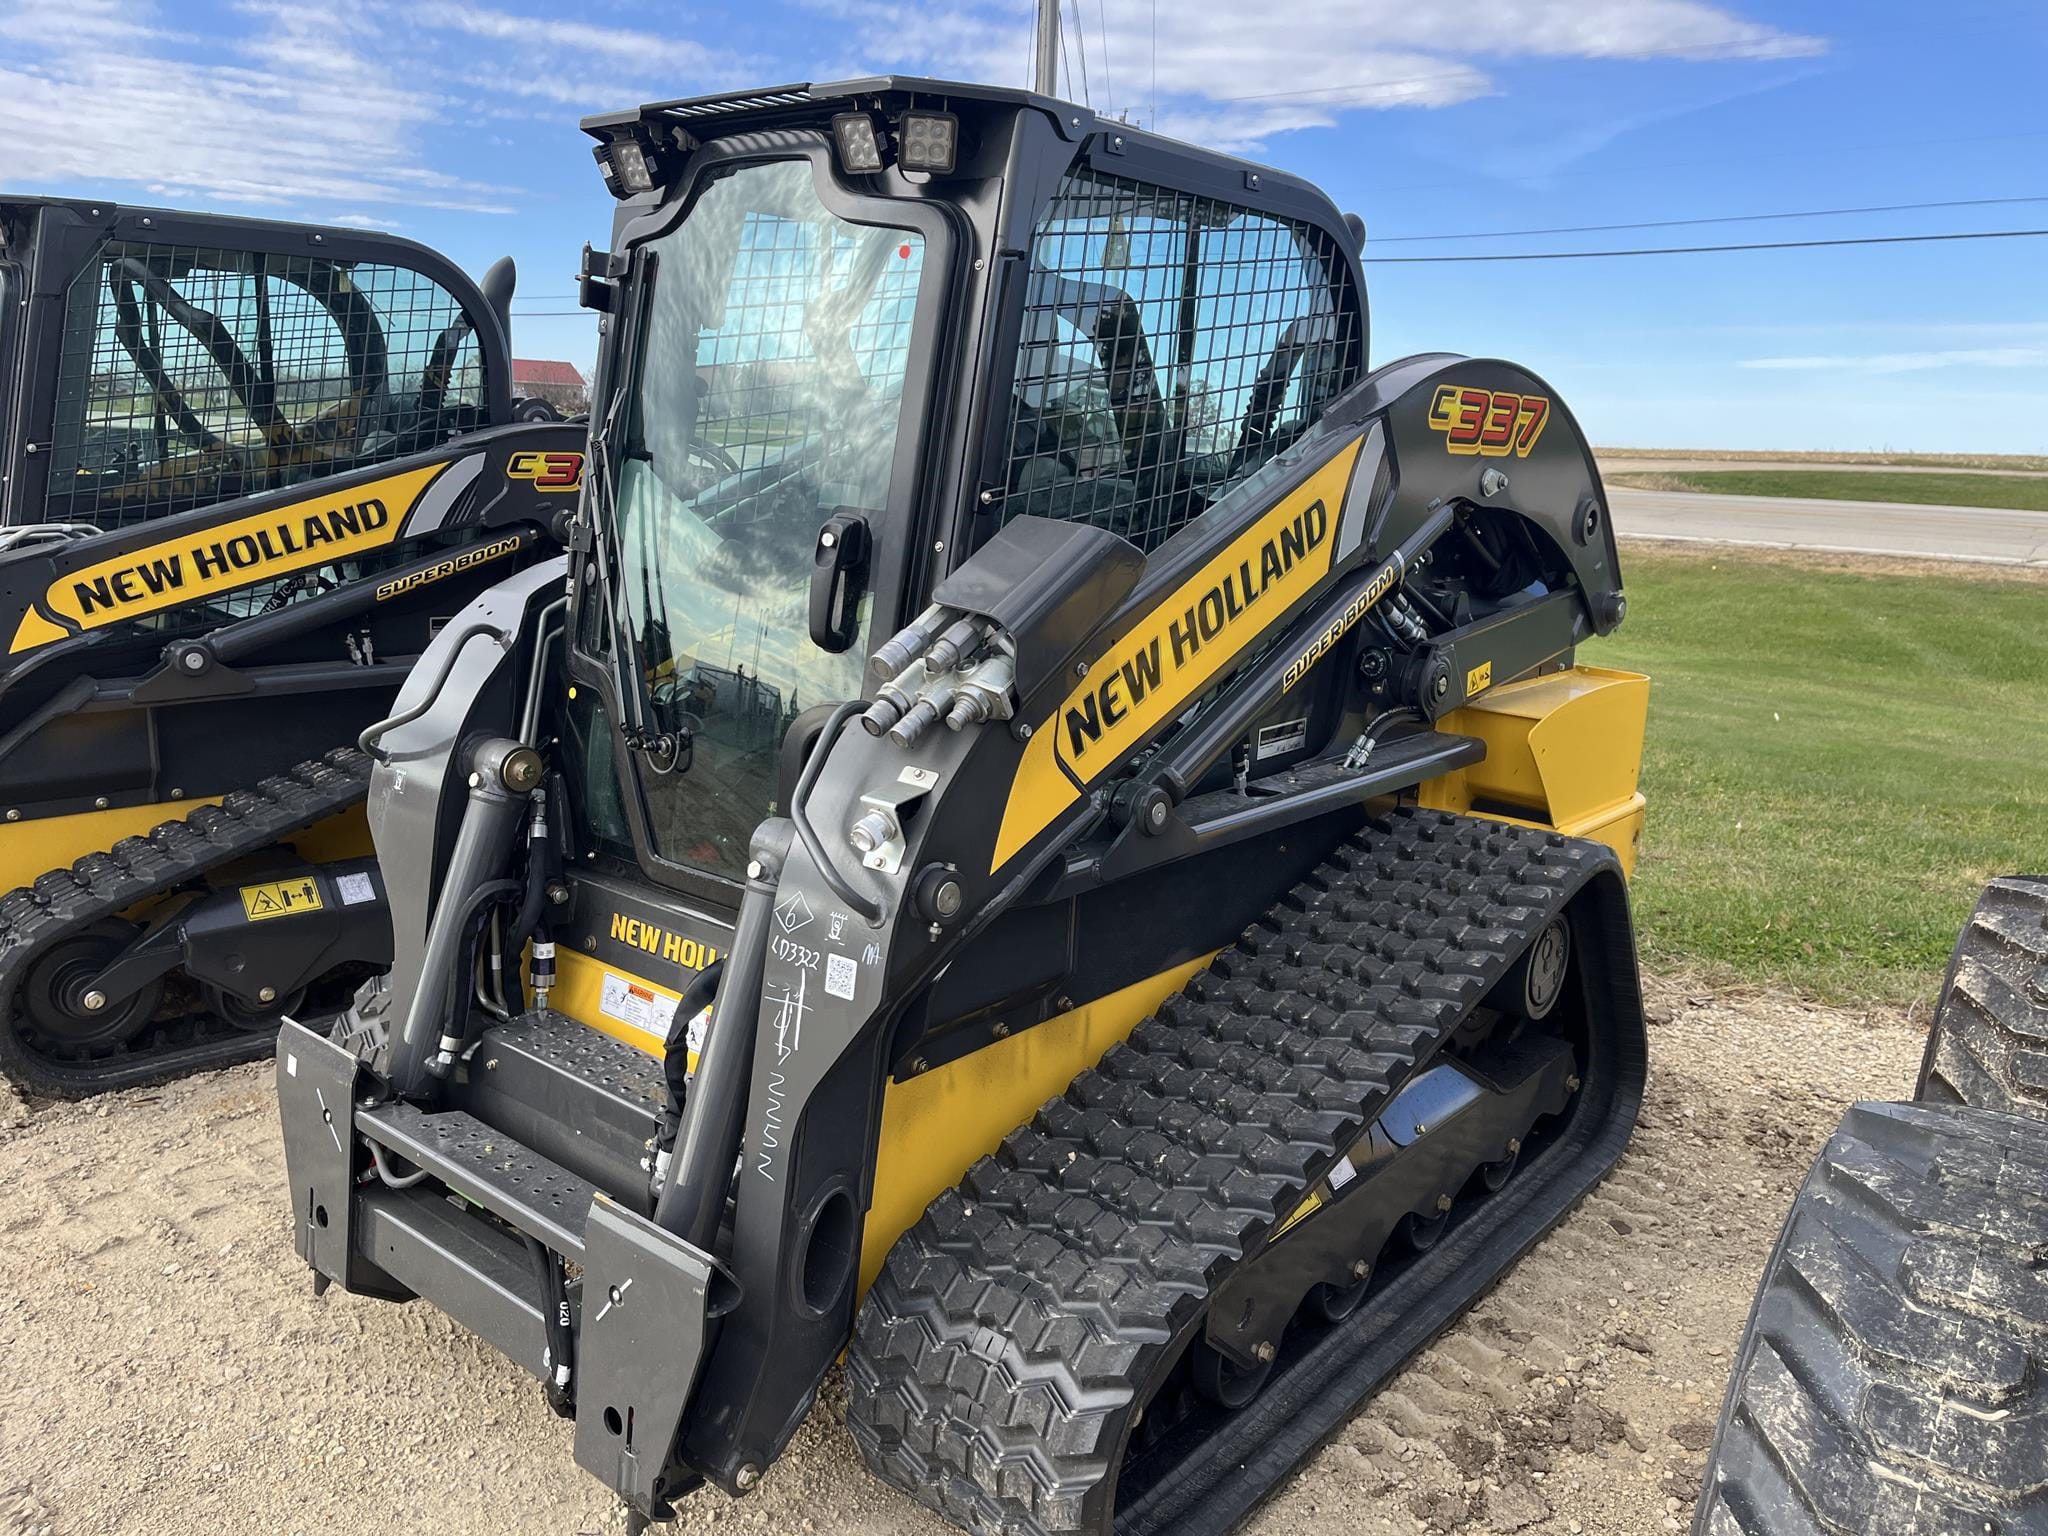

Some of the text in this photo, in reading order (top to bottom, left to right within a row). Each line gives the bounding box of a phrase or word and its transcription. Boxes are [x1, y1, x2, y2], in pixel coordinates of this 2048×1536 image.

[507, 452, 584, 492] C3
[73, 499, 389, 616] NEW HOLLAND
[376, 536, 520, 601] SUPER BOOM
[1064, 498, 1328, 759] NEW HOLLAND
[1283, 566, 1394, 694] SUPER BOOM
[610, 913, 728, 971] NEW HOLL
